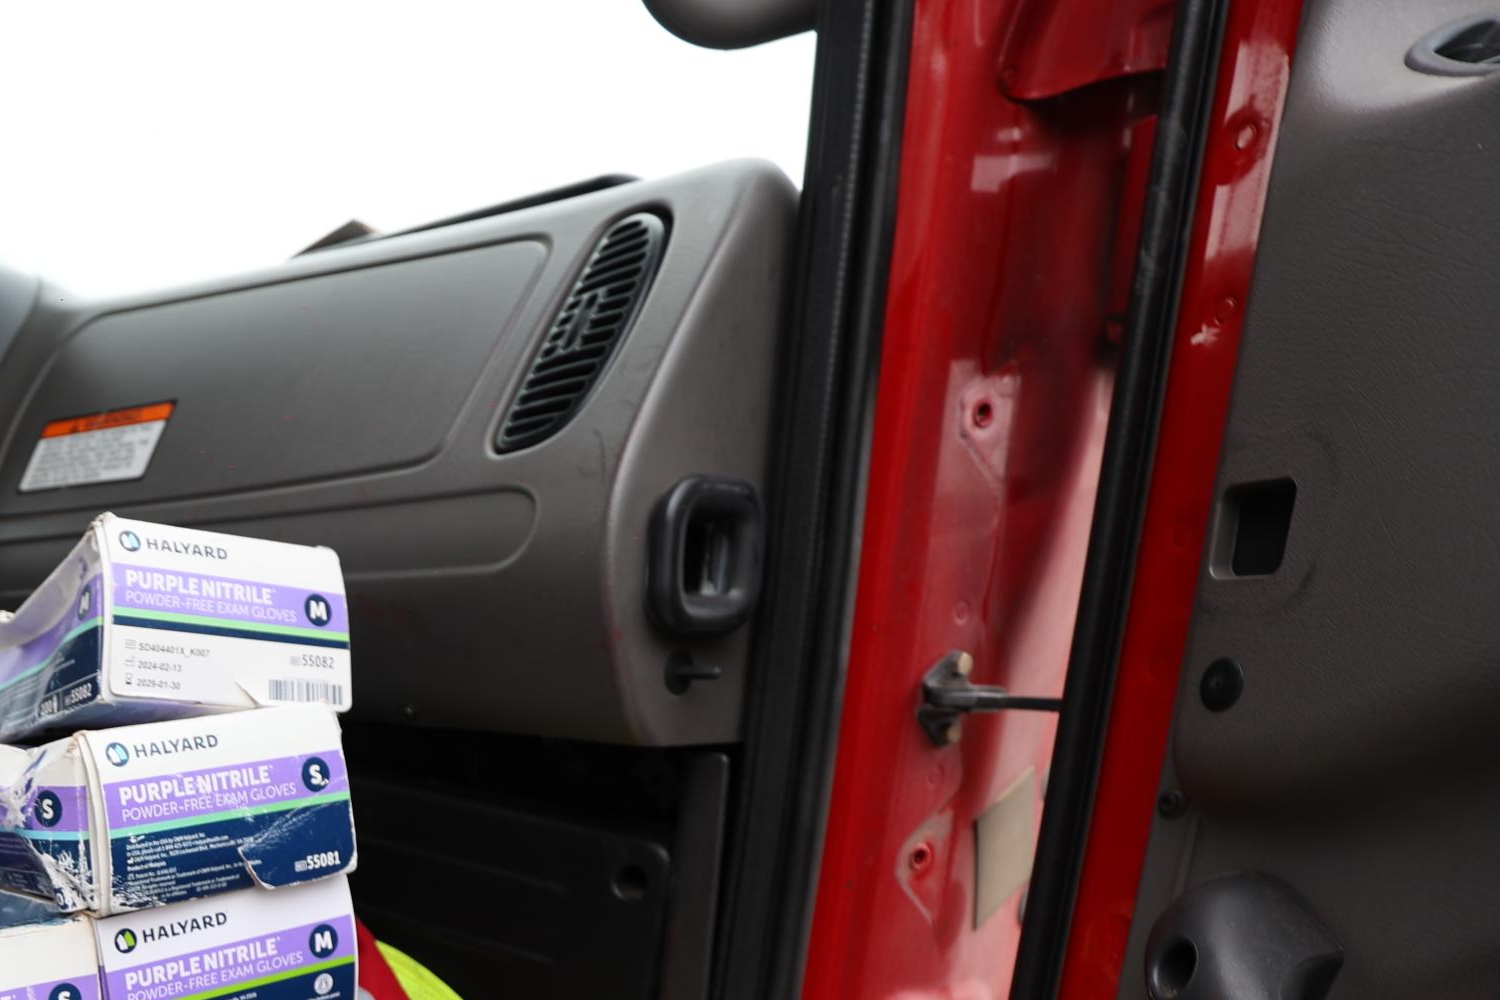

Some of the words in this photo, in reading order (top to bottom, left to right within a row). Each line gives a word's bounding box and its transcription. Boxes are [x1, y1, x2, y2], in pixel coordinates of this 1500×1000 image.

[146, 537, 228, 560] HALYARD
[125, 569, 199, 596] PURPLE
[201, 578, 273, 605] NITRILE
[125, 590, 214, 612] POWDER-FREE
[217, 601, 249, 616] EXAM
[251, 605, 297, 622] GLOVES
[309, 599, 328, 621] M
[301, 653, 334, 669] 55082
[133, 734, 219, 758] HALYARD
[119, 777, 197, 806] PURPLE
[197, 765, 271, 795] NITRILE
[309, 764, 323, 785] S
[42, 799, 54, 819] S
[122, 795, 213, 822] POWDER-FREE
[216, 790, 249, 807] EXAM
[251, 782, 297, 801] GLOVES
[306, 850, 341, 870] 55081
[142, 912, 227, 943] HALYARD
[315, 930, 333, 953] M
[125, 956, 202, 991] PURPLE
[203, 937, 278, 971] NITRILE
[221, 964, 254, 982] EXAM
[257, 951, 303, 973] GLOVES
